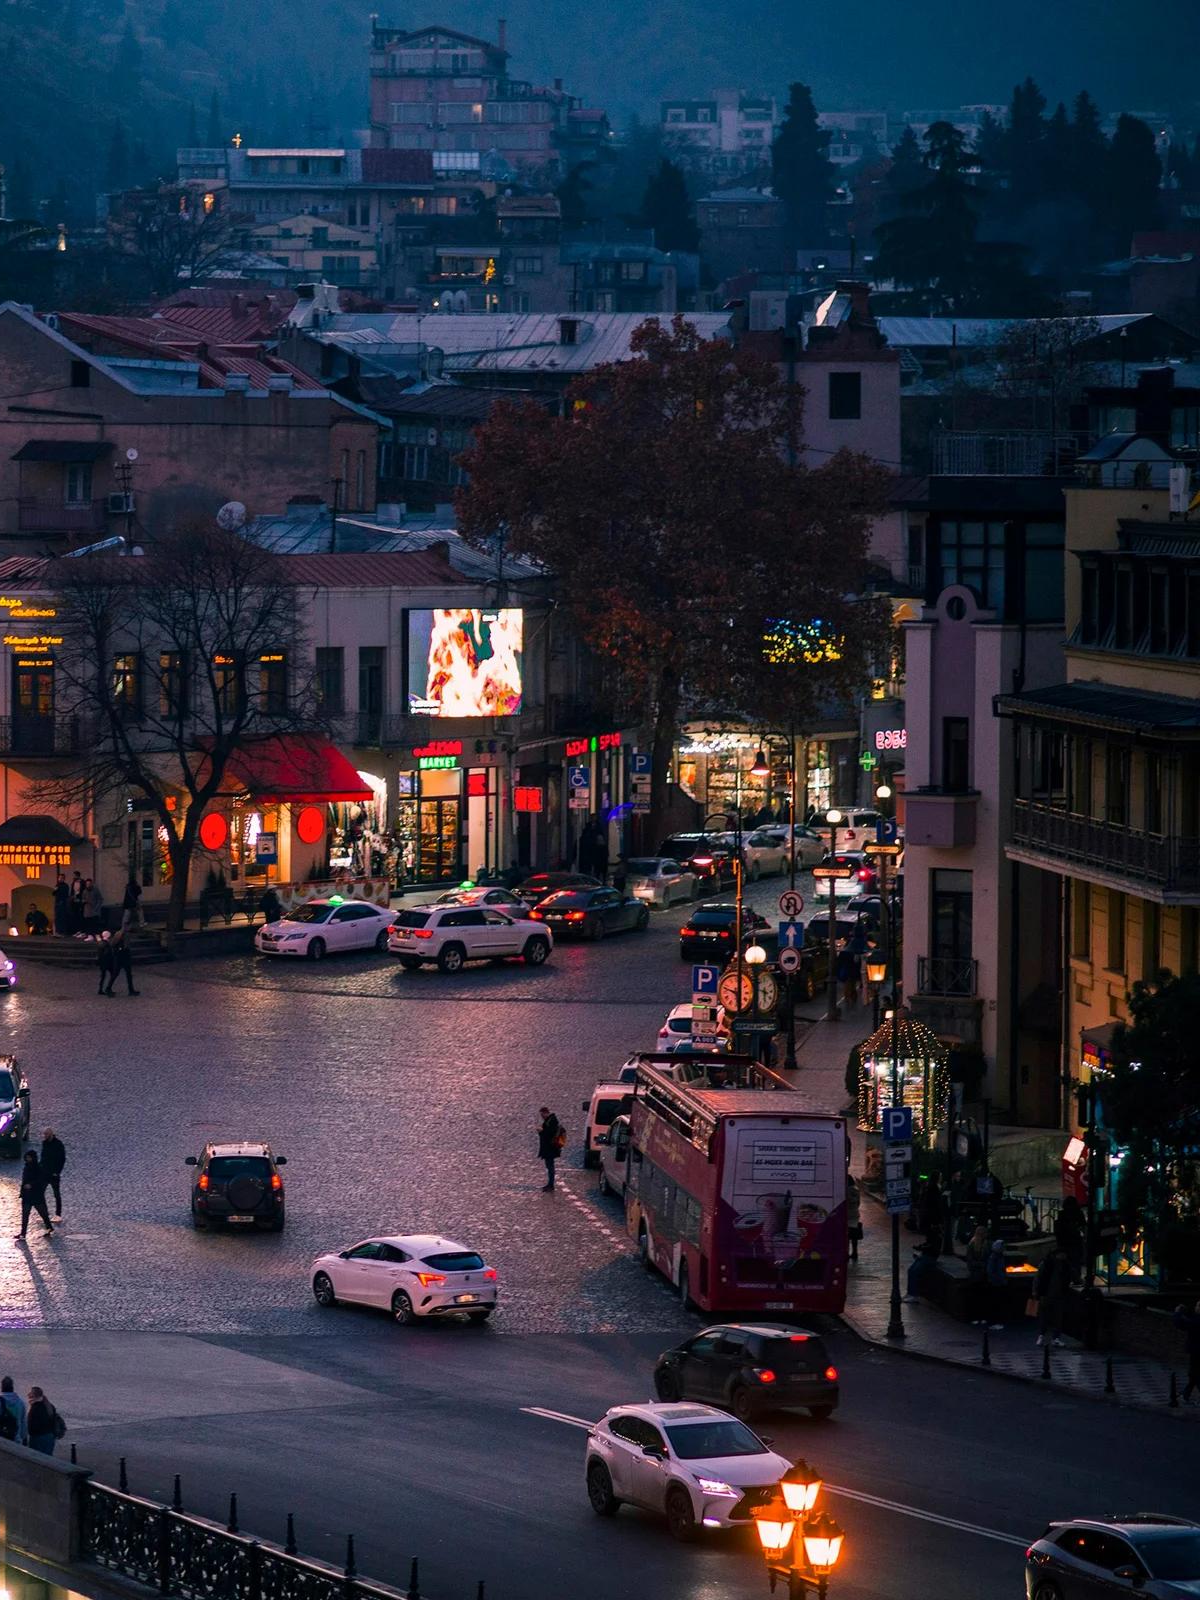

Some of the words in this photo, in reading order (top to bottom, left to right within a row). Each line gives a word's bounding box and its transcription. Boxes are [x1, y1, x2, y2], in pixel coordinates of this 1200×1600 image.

[419, 757, 457, 769] MARKET
[636, 755, 647, 771] P
[49, 854, 71, 865] BAR
[697, 968, 713, 991] P
[889, 1111, 905, 1137] P
